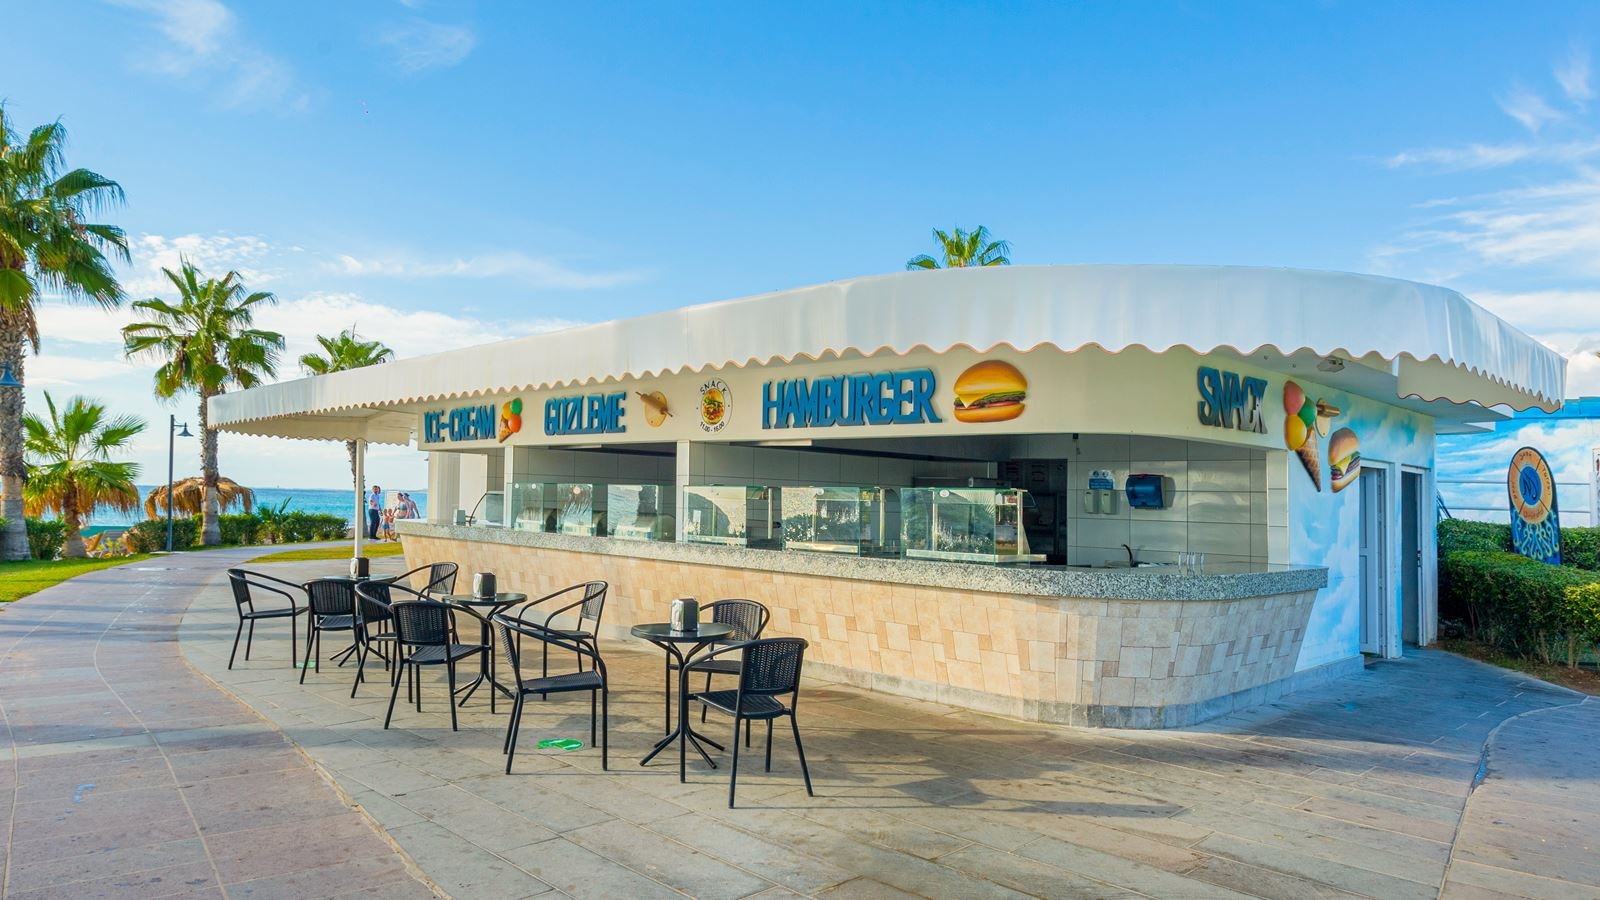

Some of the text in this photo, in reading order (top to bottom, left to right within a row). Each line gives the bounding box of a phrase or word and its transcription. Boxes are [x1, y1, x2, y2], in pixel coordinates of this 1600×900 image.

[700, 380, 727, 395] SNACK
[762, 367, 943, 430] HAMBURGER
[1197, 366, 1268, 434] SNACK
[424, 404, 496, 443] ICE-CREAM
